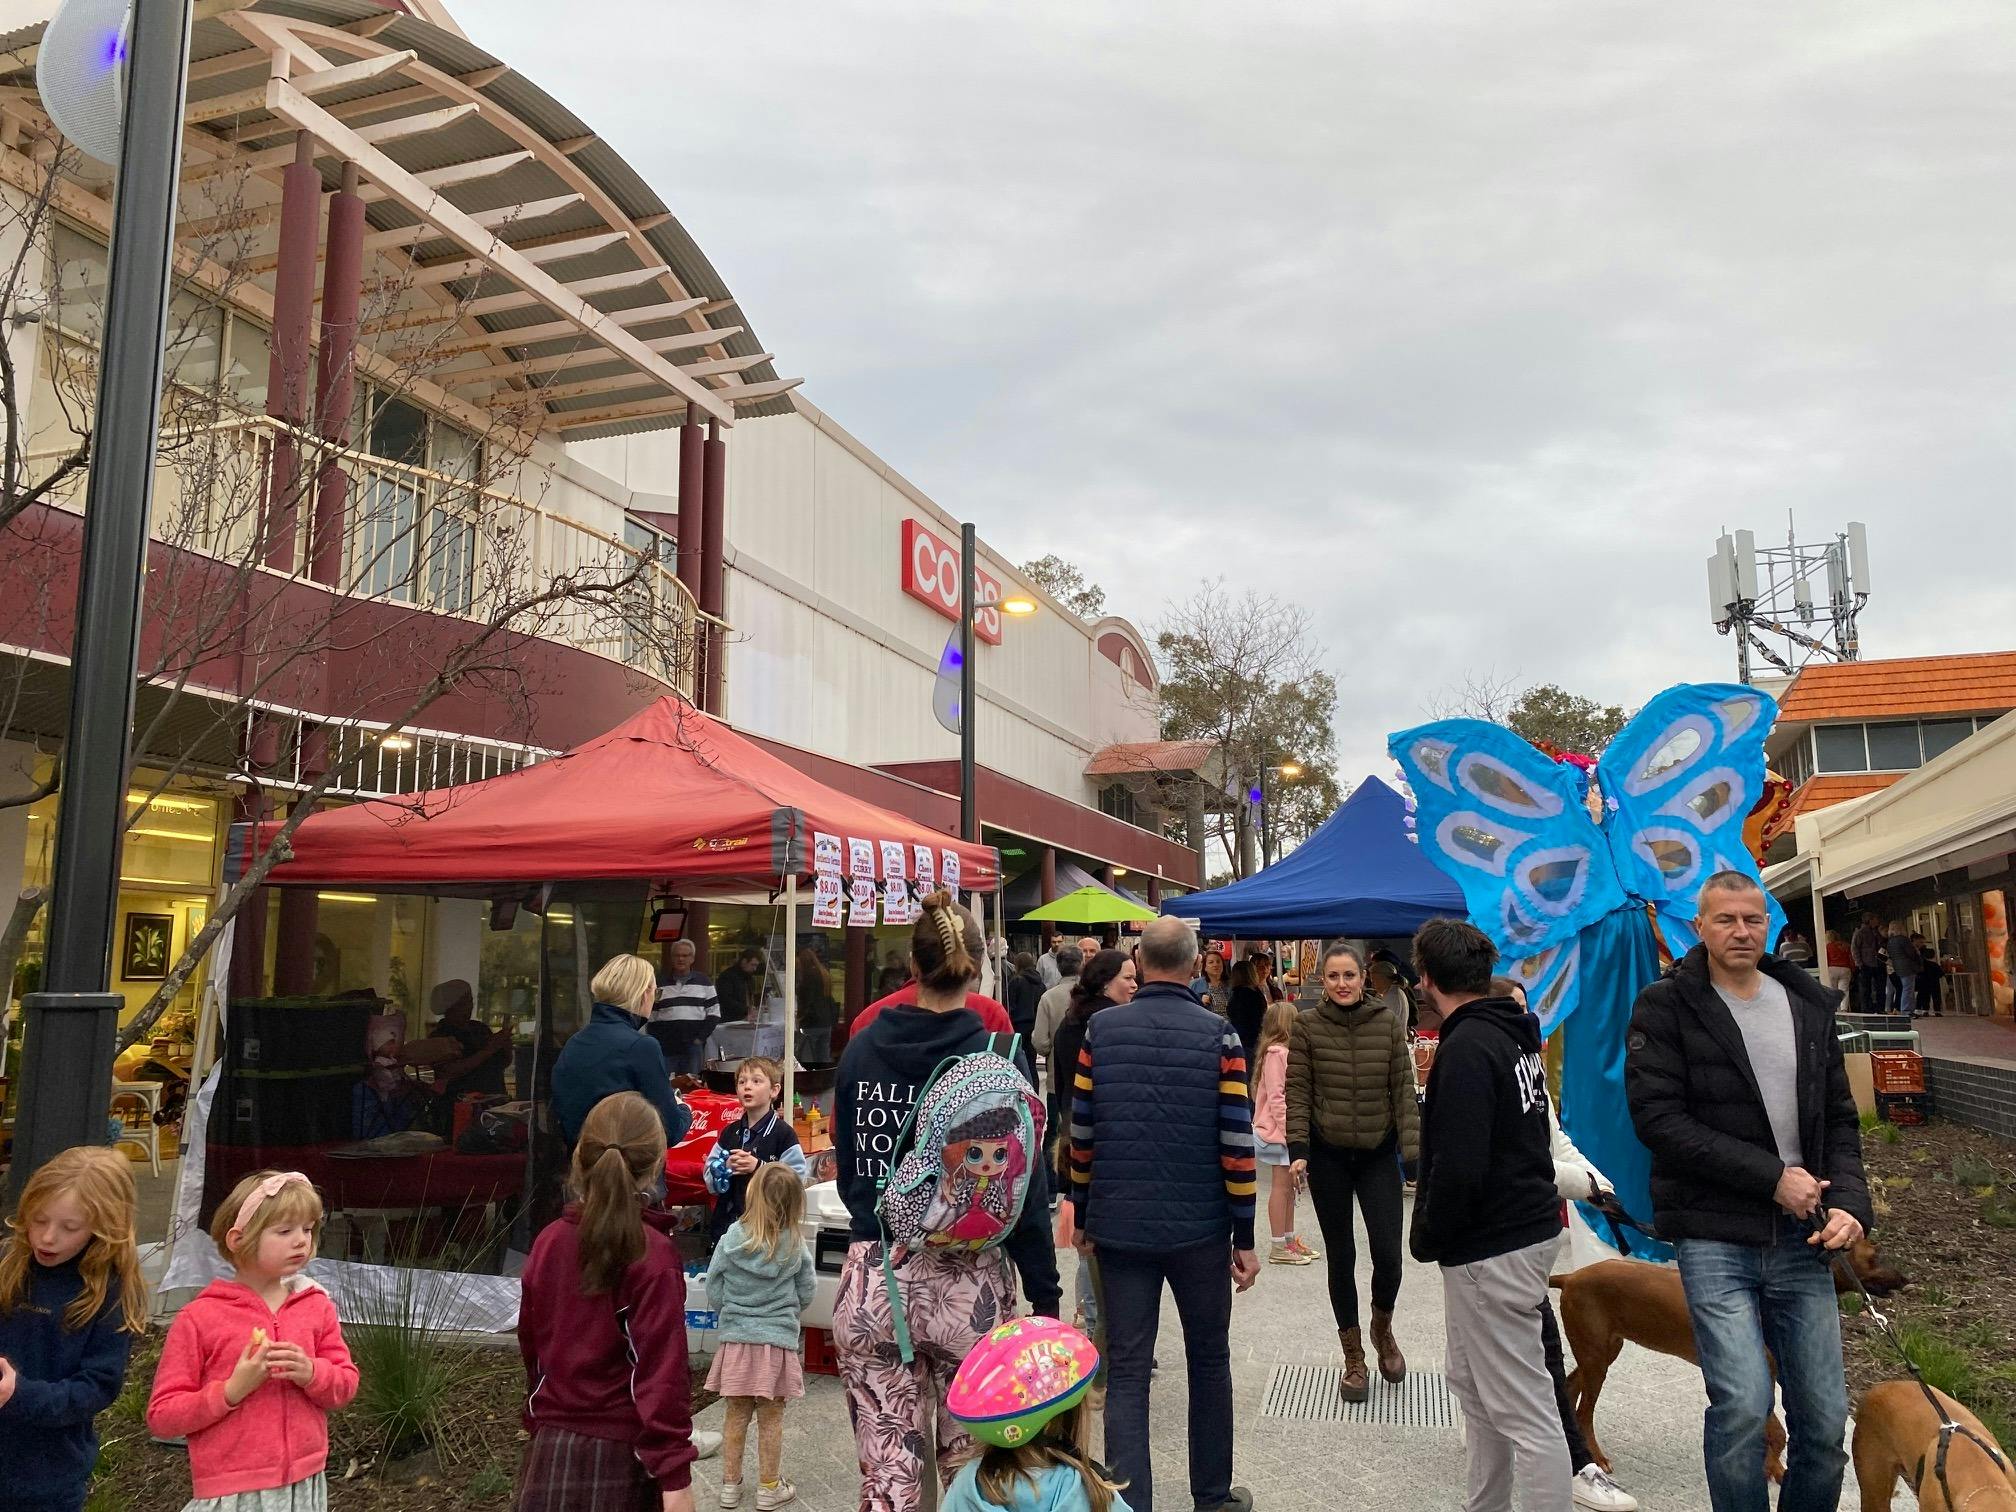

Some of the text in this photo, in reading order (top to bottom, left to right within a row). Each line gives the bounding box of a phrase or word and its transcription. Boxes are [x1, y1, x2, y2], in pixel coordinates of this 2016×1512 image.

[819, 879, 839, 895] $8.00
[857, 1081, 917, 1104] FALL
[856, 1132, 900, 1153] NO
